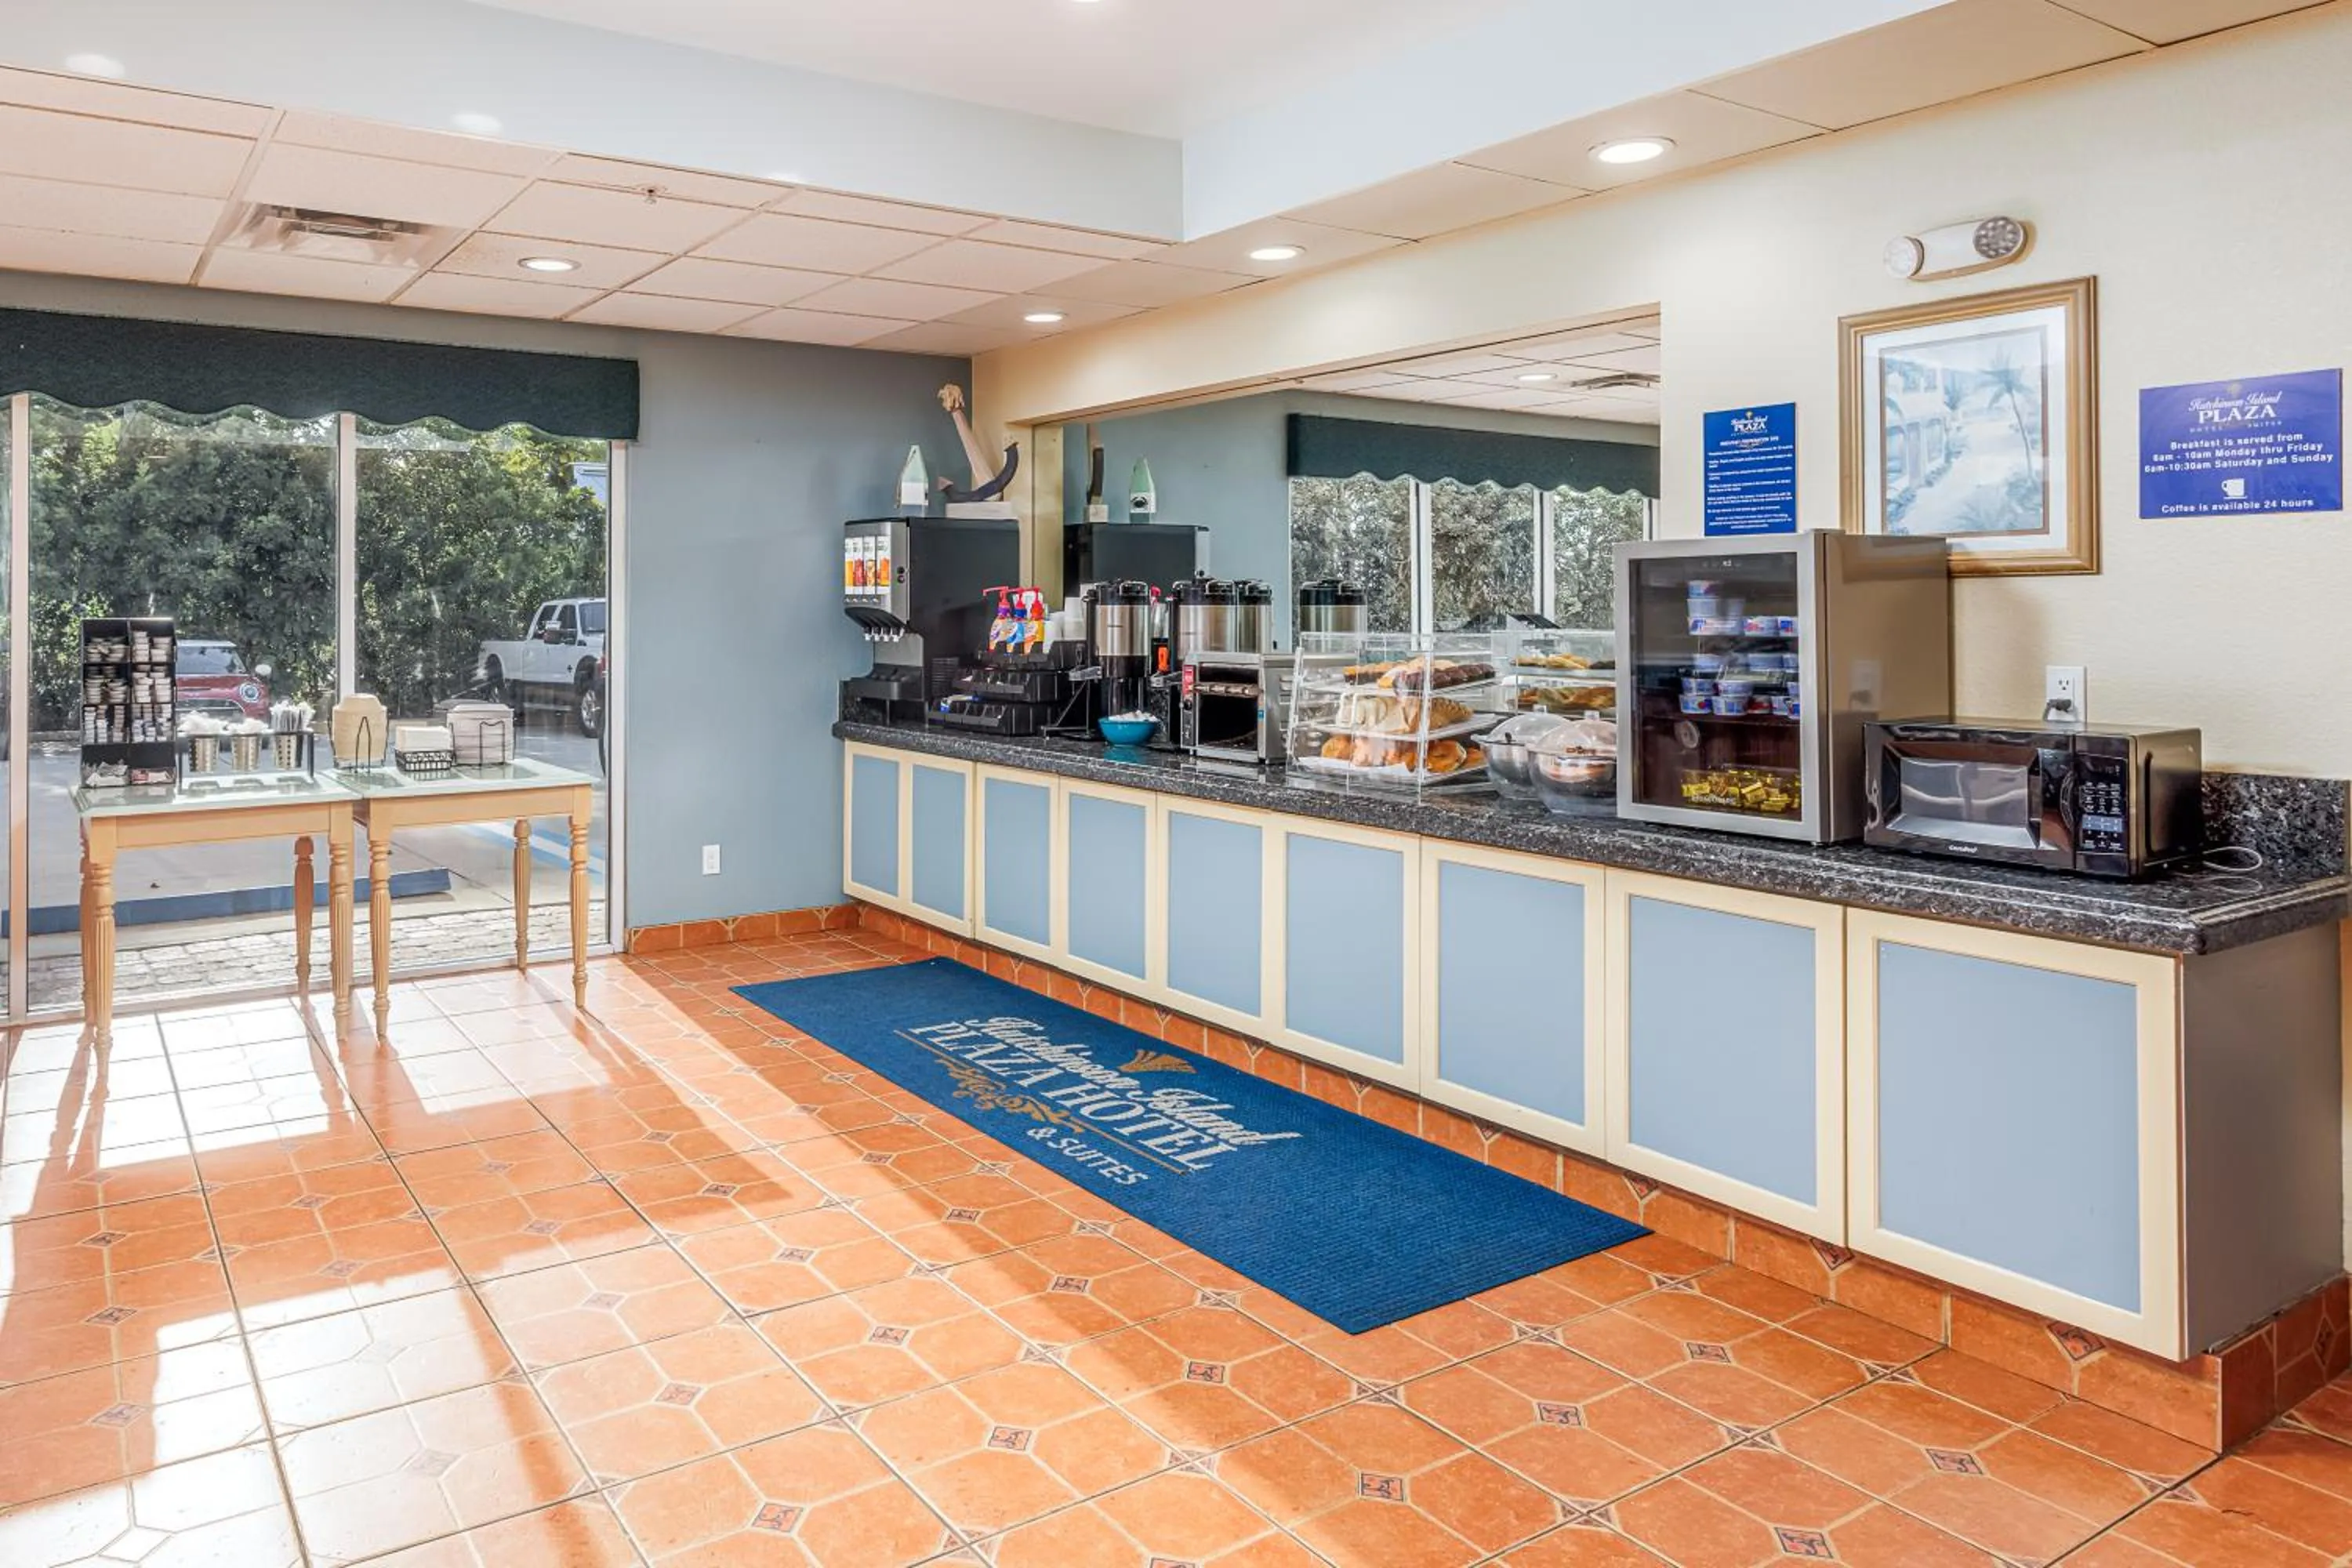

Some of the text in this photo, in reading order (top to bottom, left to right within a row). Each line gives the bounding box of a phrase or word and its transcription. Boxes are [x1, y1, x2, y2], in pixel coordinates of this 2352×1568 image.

[2198, 404, 2278, 424] PLAZA
[2169, 432, 2304, 451] Breakfast is served from
[2185, 450, 2212, 460] 10am
[2215, 445, 2257, 458] Monday
[2260, 445, 2284, 455] thru
[2287, 441, 2324, 452] Friday
[2144, 452, 2334, 474] 6am-10:30am Saturday and Sunday
[2161, 499, 2315, 514] Coffee is available 24 hours
[908, 1021, 1238, 1171] PLAZA HOTEL
[1026, 1127, 1149, 1185] & SUITES
